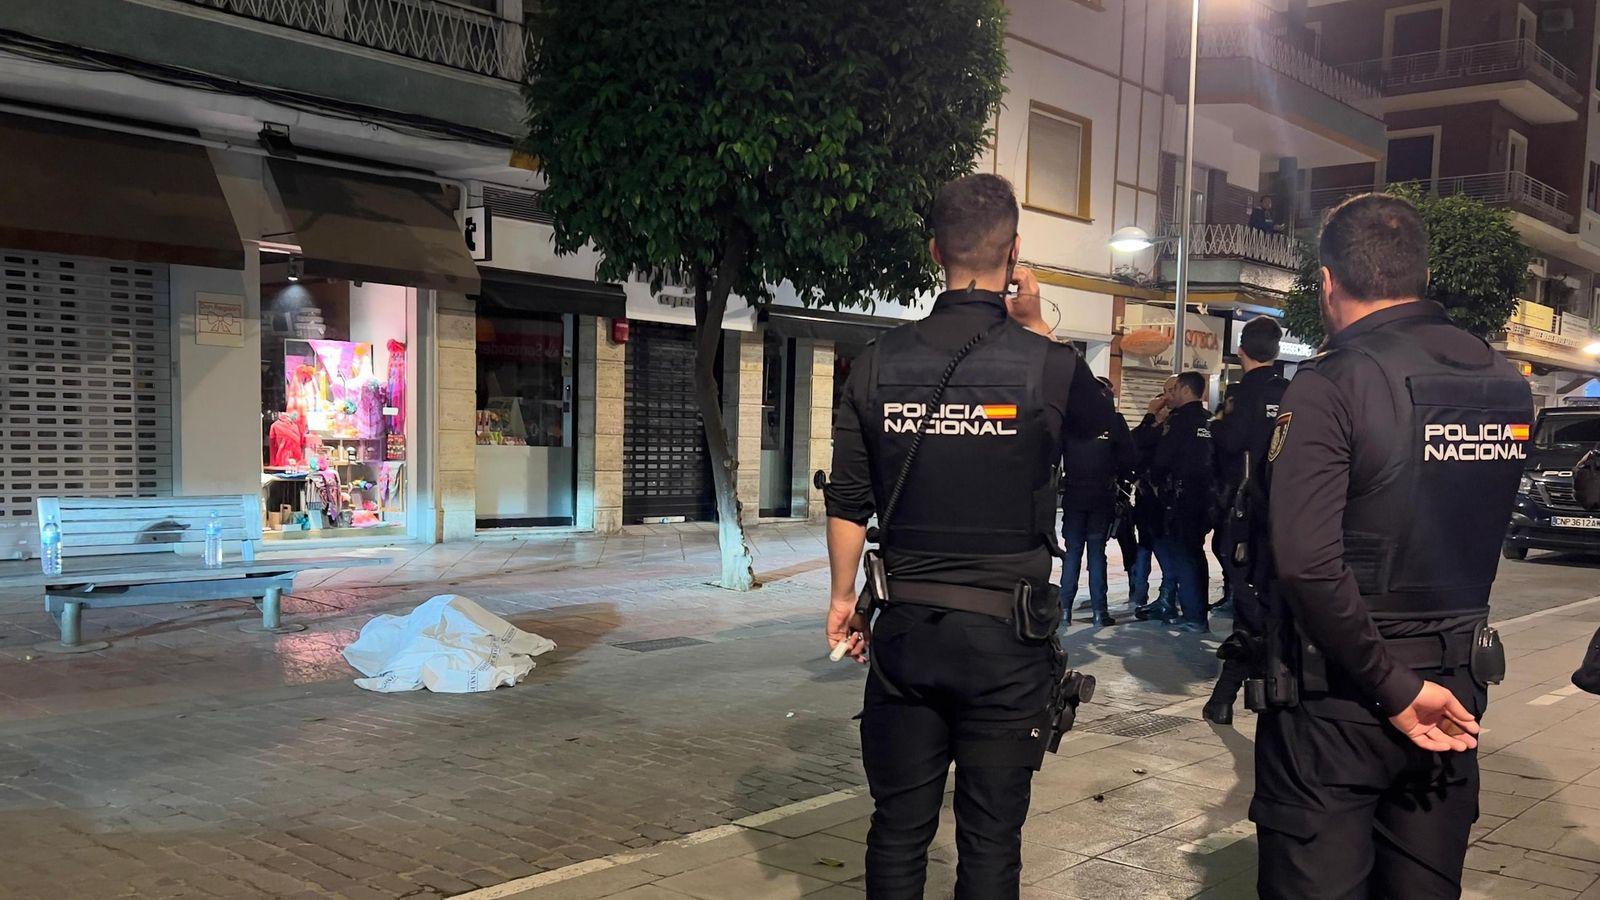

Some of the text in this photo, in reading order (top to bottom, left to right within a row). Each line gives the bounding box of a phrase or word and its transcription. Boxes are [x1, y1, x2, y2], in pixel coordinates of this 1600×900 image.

[883, 402, 989, 420] POLICIA
[884, 418, 1017, 435] NACIONAL
[1424, 423, 1514, 441] POLICIA
[1424, 443, 1527, 461] NACIONAL
